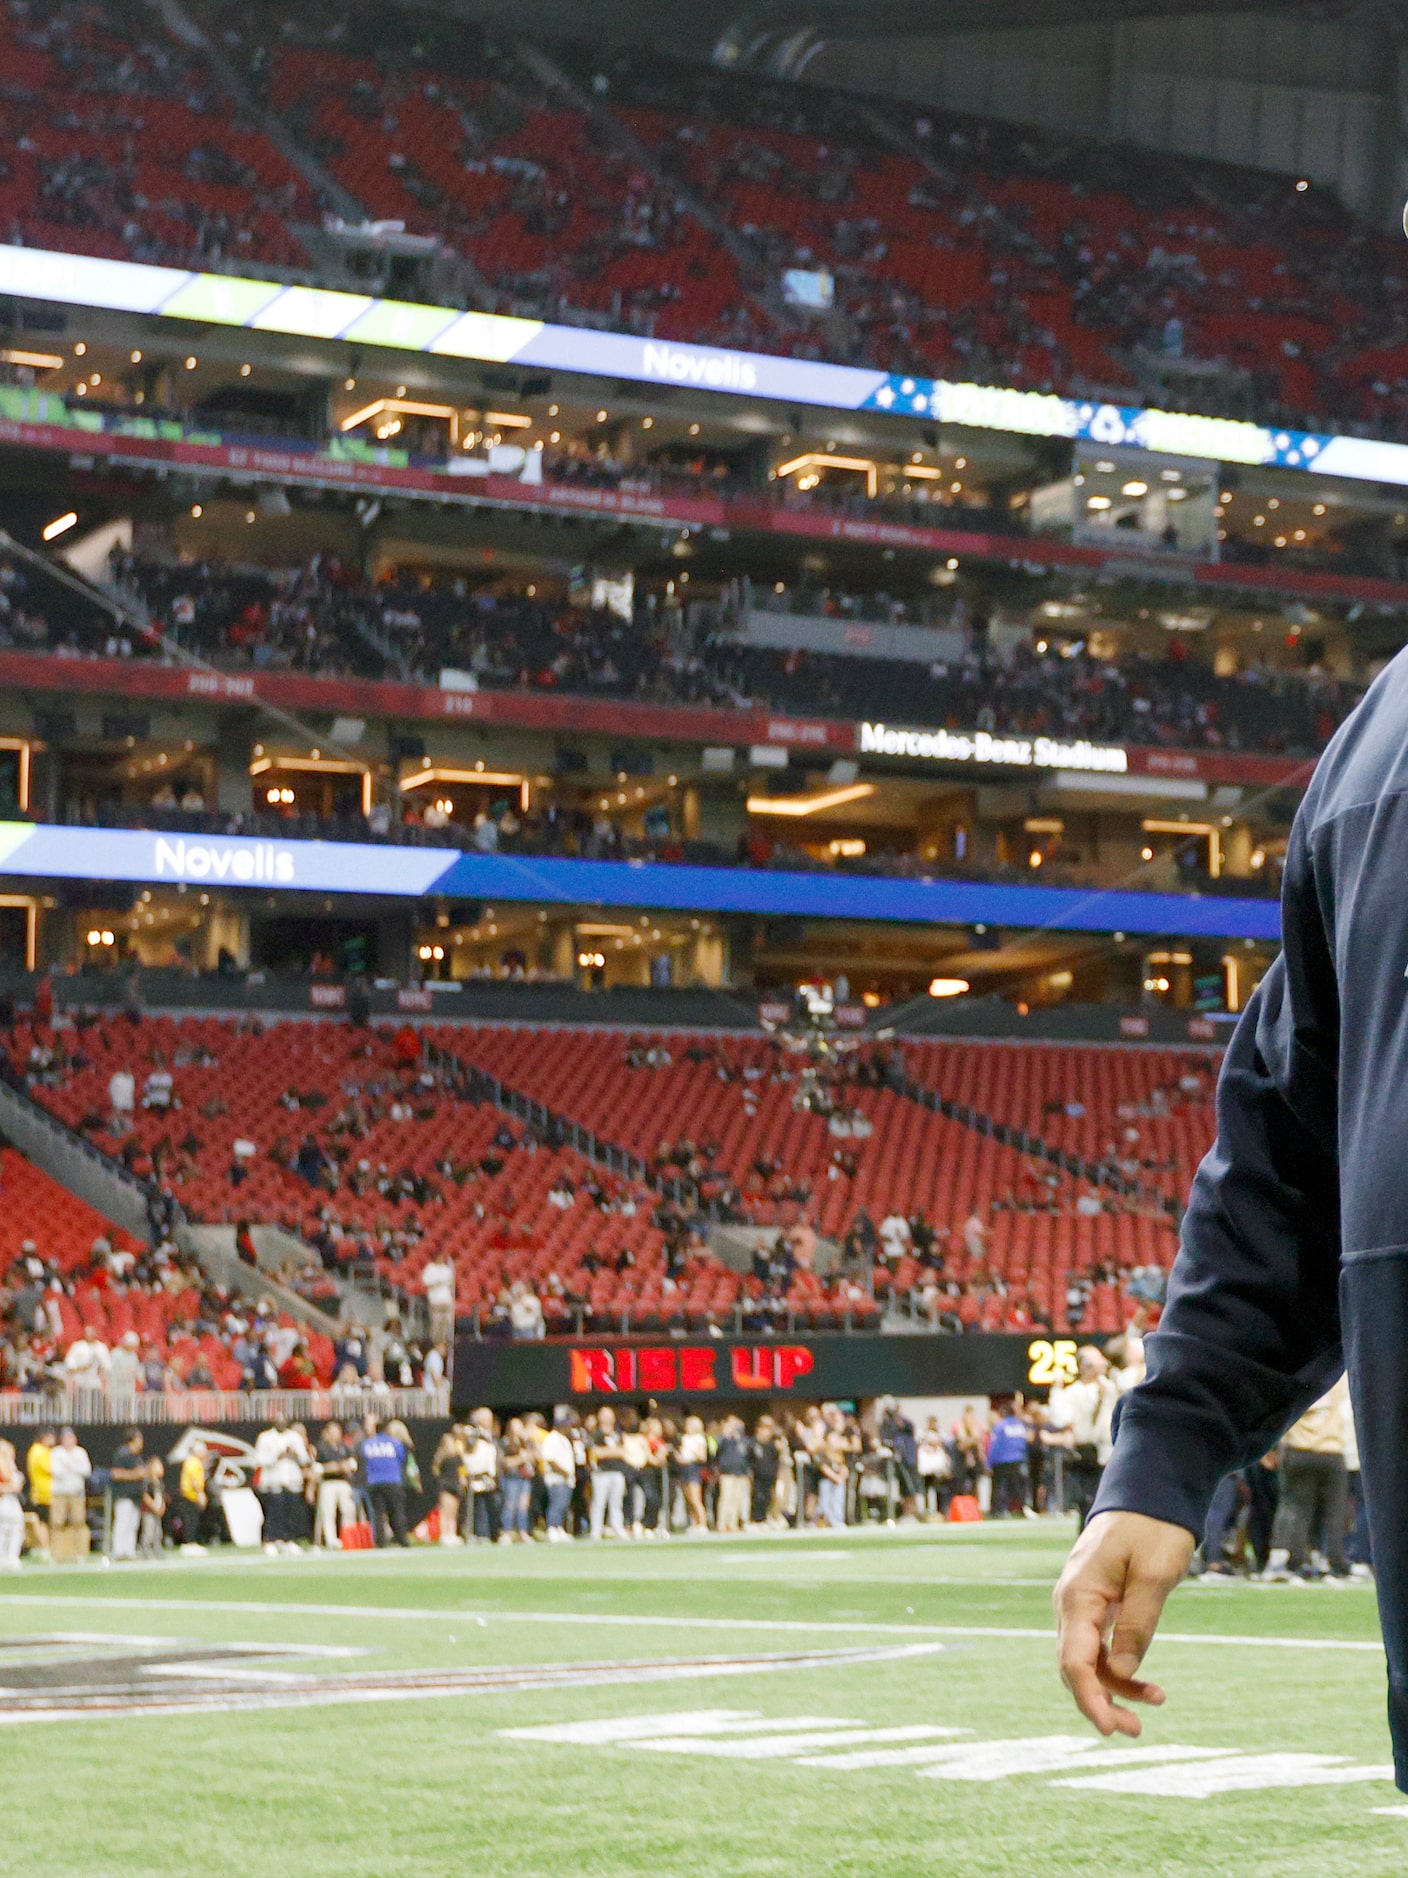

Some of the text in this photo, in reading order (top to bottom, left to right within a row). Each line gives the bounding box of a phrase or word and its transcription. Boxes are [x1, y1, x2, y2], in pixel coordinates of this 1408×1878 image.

[643, 343, 757, 389] Novelis
[861, 722, 1032, 766] Mercedes-Benz
[1034, 737, 1127, 772] Stadium
[155, 837, 294, 882] Novelis
[570, 1345, 815, 1392] RISE UP
[1028, 1339, 1079, 1385] 25
